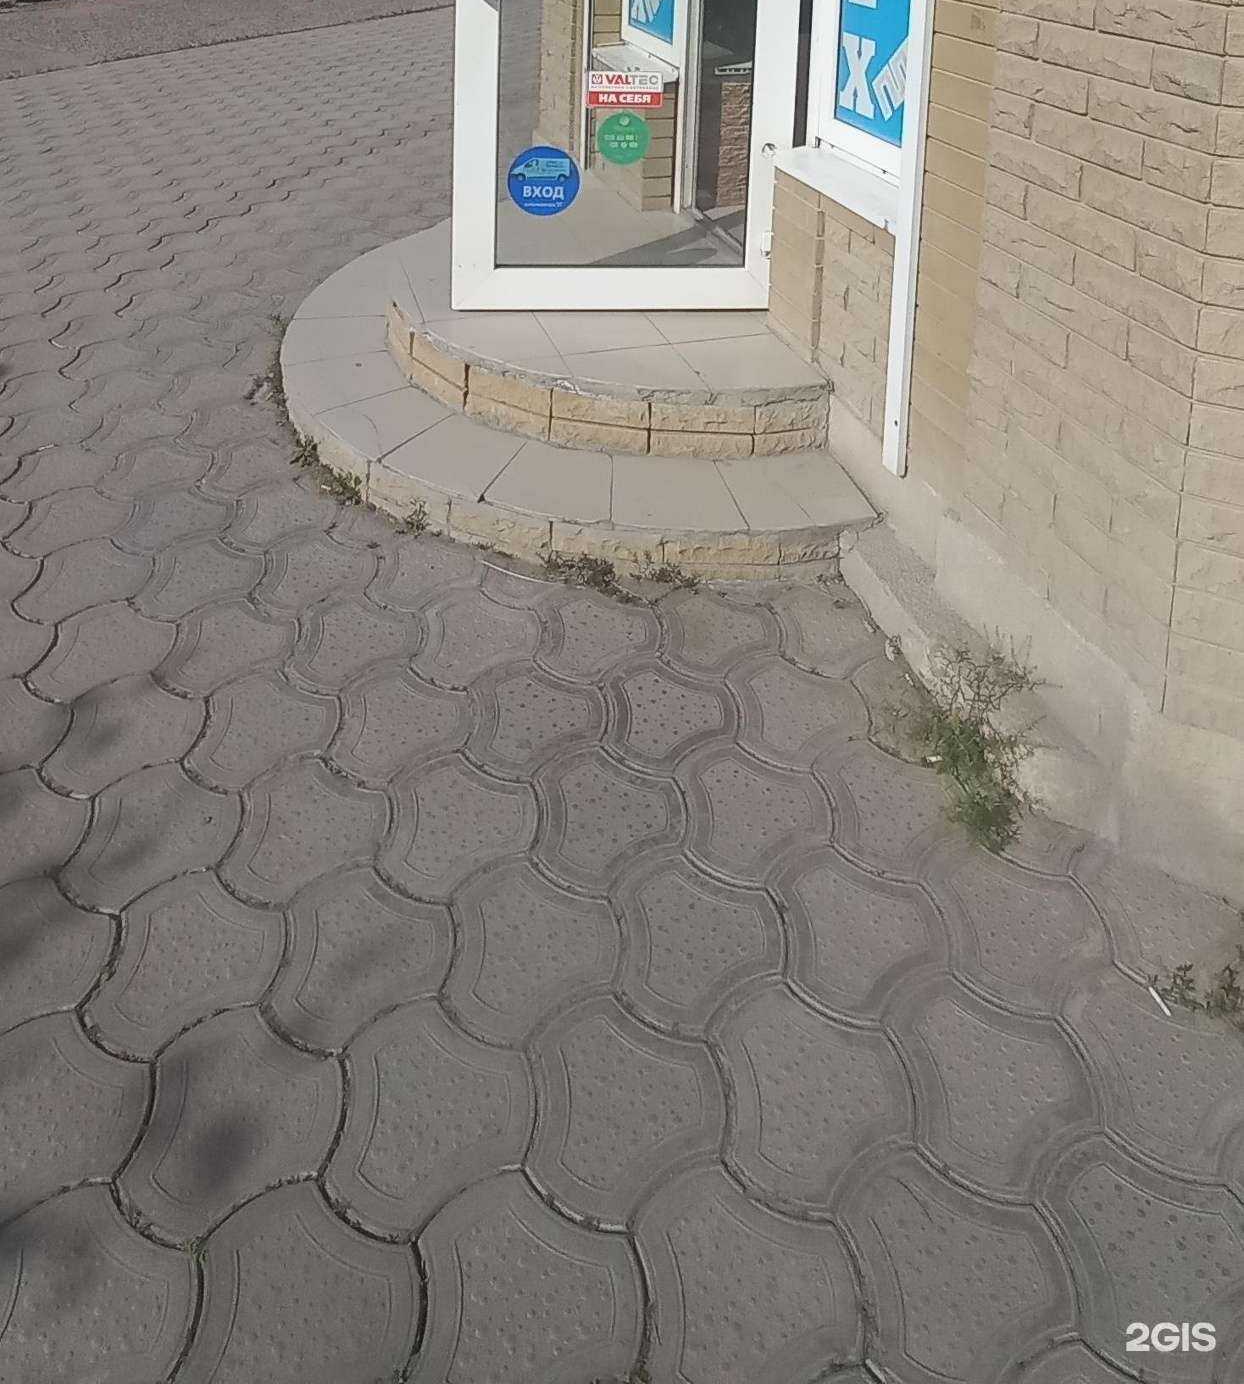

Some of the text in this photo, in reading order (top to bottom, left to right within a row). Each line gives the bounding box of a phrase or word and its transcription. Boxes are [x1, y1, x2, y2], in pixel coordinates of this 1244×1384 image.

[604, 74, 659, 85] VALTEC
[598, 93, 652, 104] НА СЕБЯ
[523, 185, 565, 200] ВХОД
